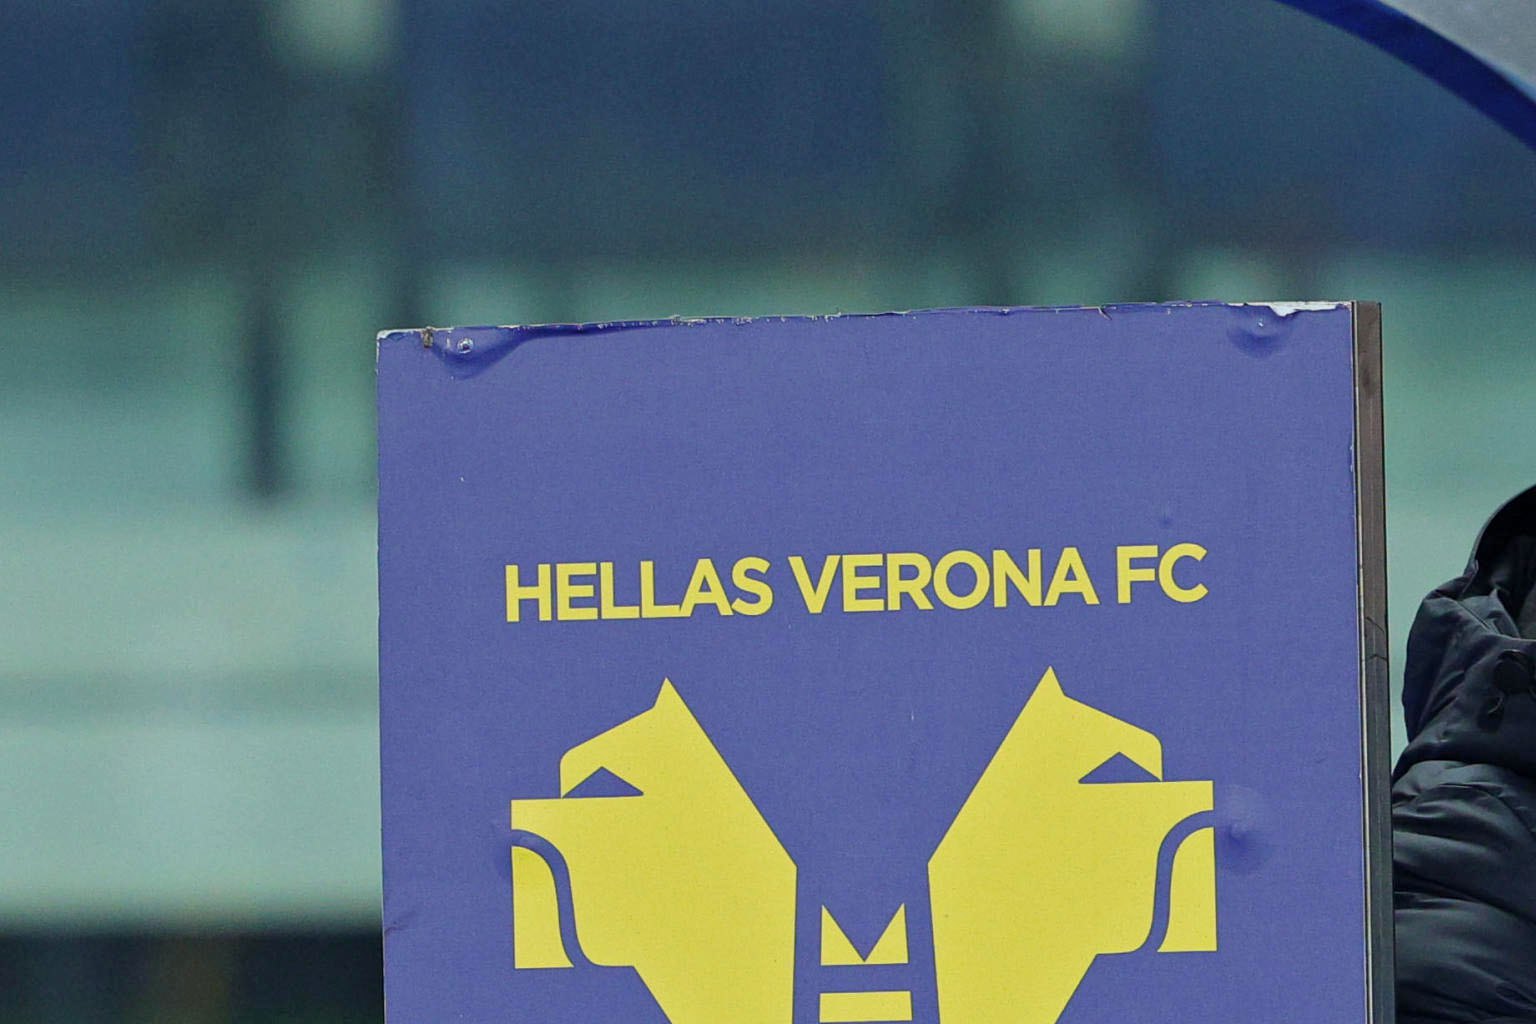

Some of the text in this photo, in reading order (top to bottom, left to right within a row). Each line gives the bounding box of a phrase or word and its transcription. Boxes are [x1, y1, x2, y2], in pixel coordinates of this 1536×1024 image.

[505, 542, 1209, 623] HELLAS VERONA FC
